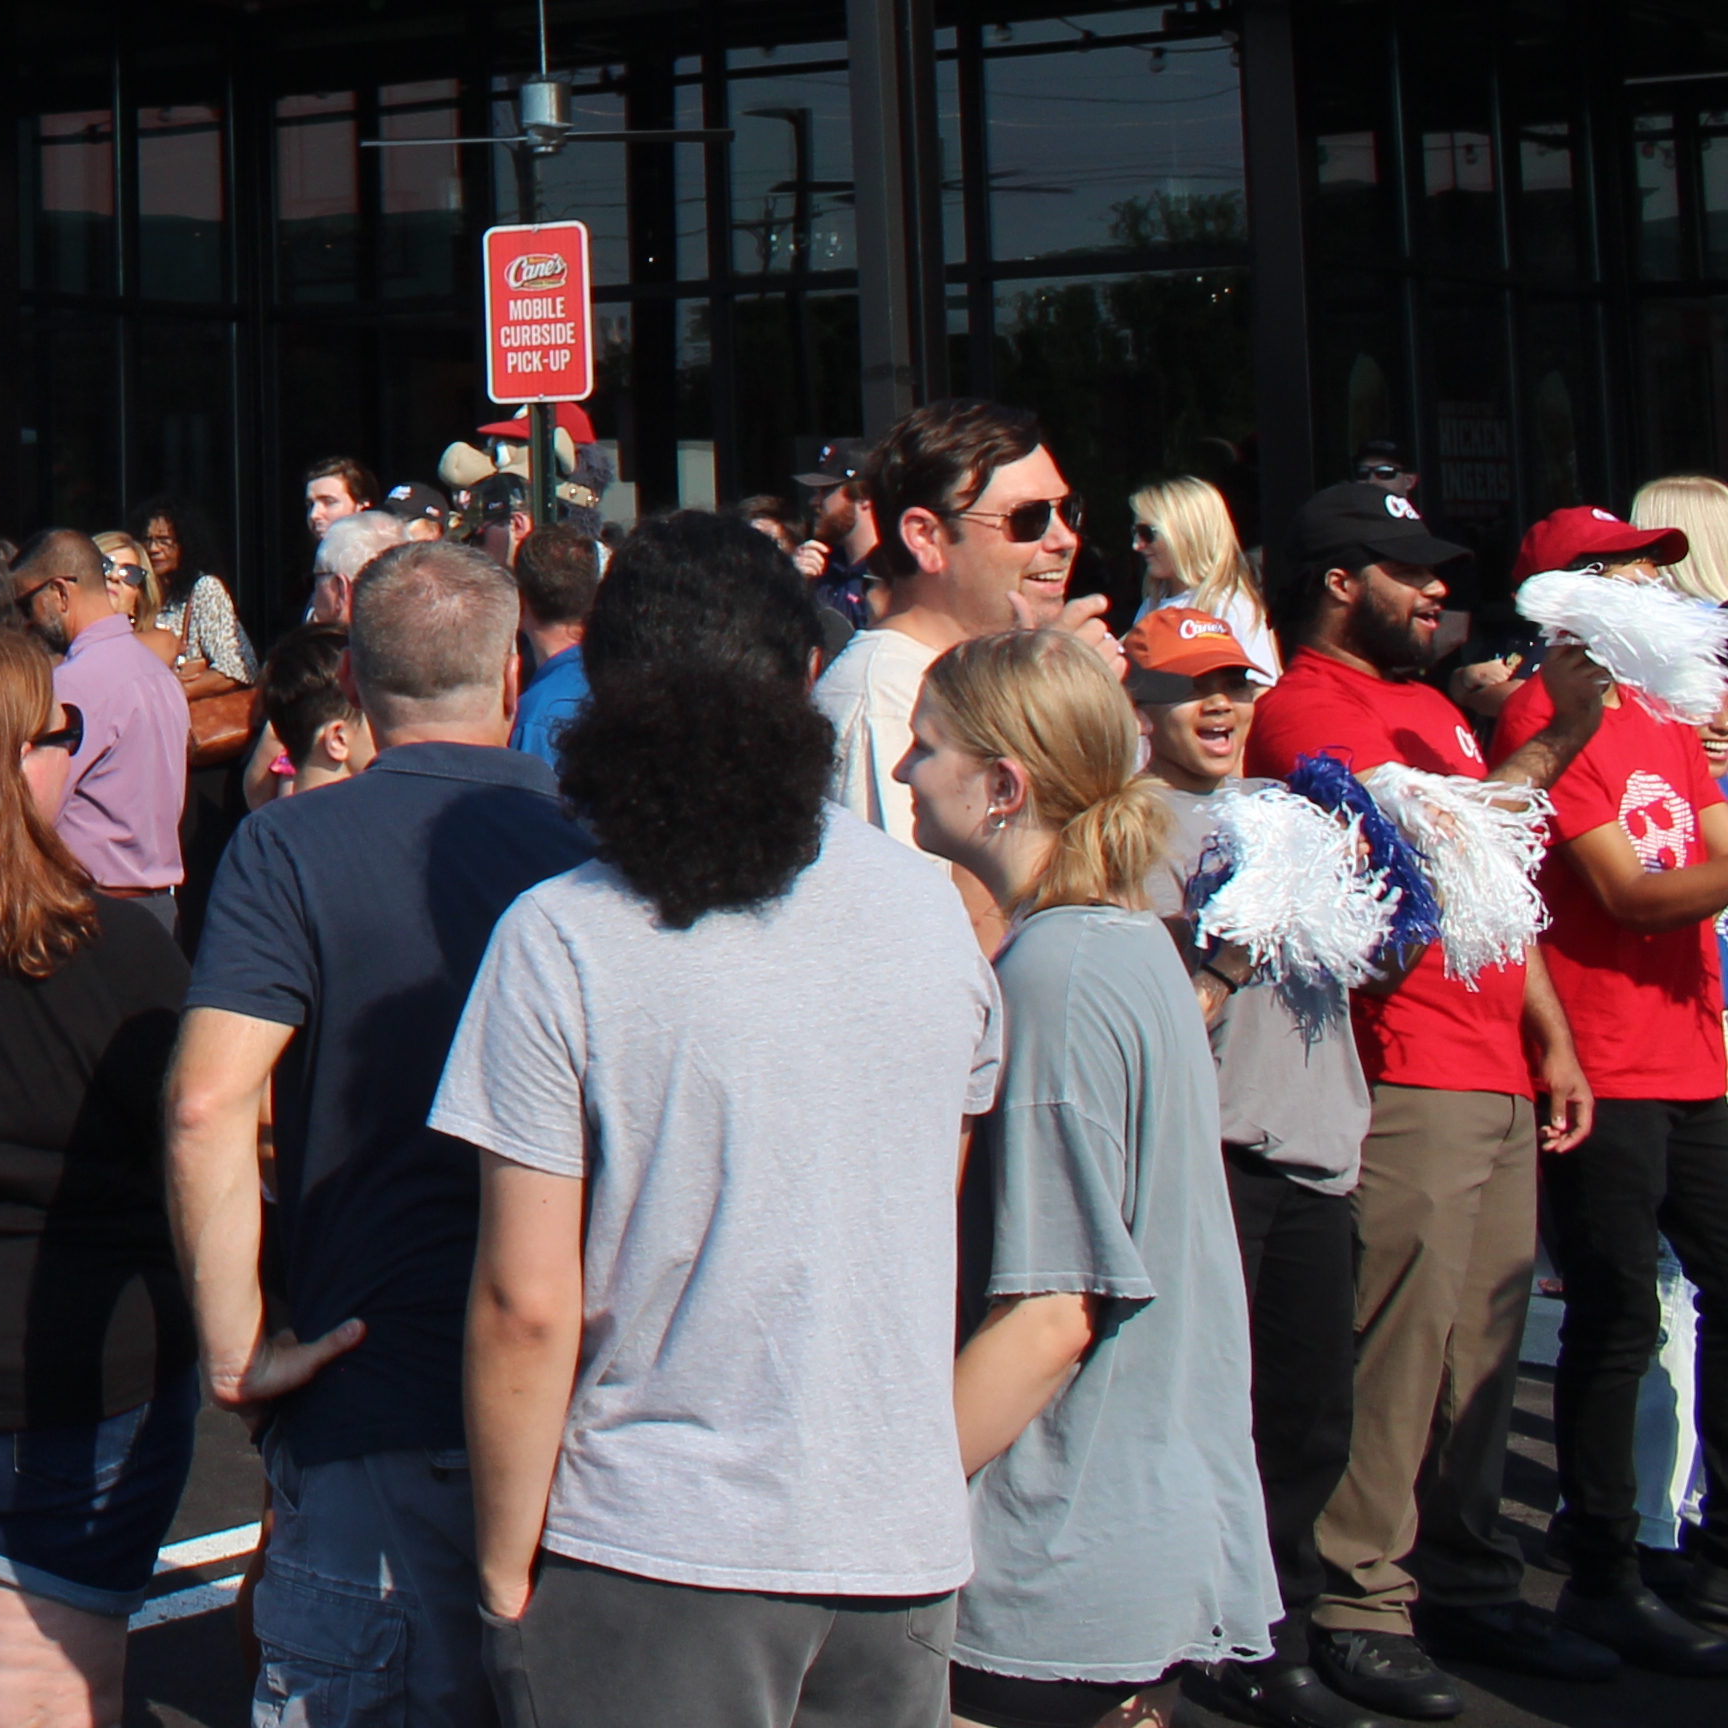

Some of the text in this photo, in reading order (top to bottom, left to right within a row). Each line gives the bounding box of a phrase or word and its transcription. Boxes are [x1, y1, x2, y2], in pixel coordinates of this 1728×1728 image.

[509, 253, 567, 288] Cane's
[509, 297, 566, 321] MOBILE
[500, 322, 575, 348] CURBSIDE
[507, 349, 571, 373] PICK-UP
